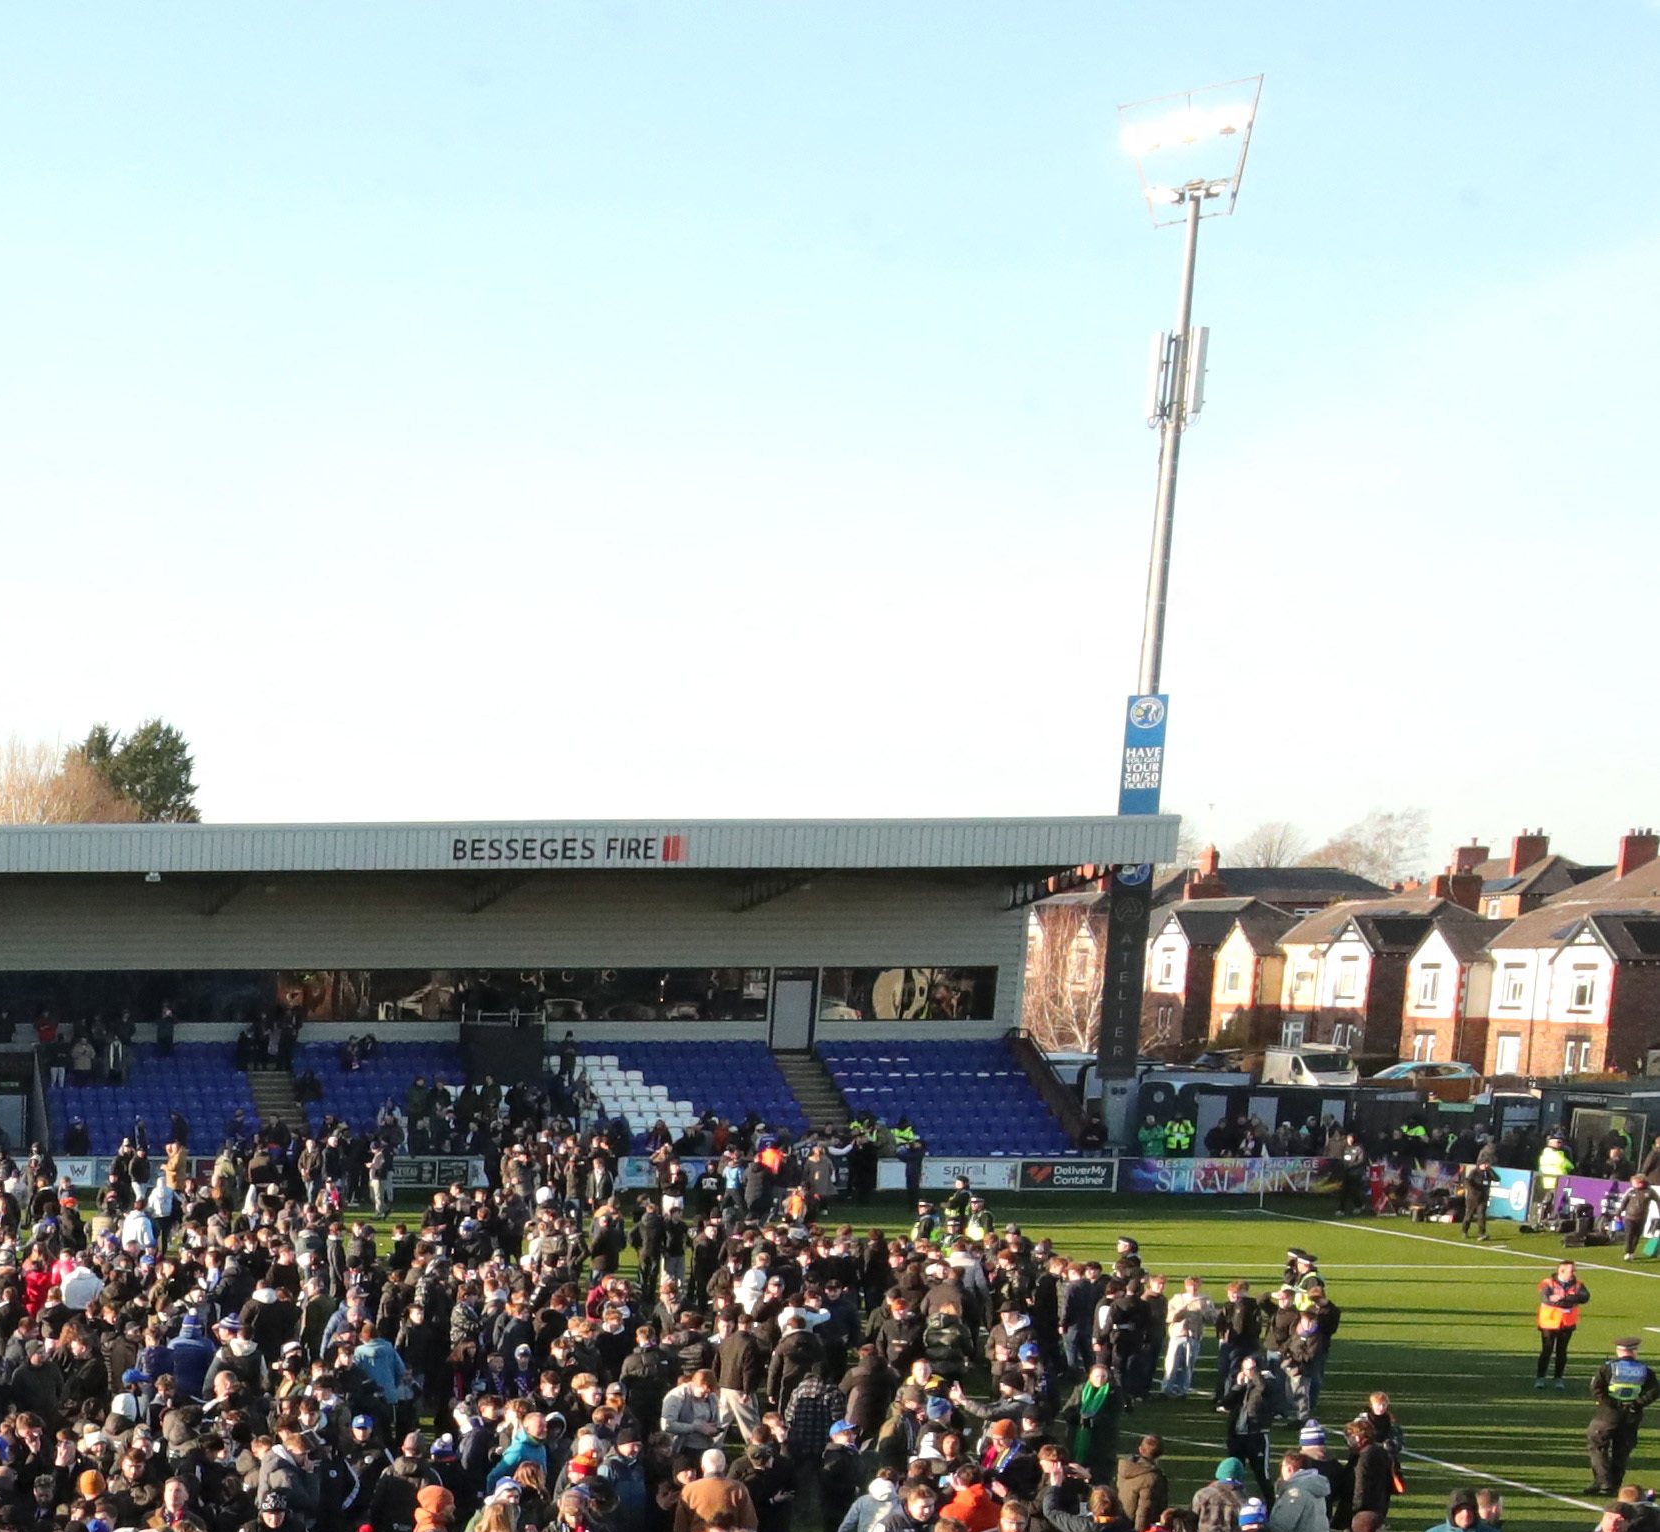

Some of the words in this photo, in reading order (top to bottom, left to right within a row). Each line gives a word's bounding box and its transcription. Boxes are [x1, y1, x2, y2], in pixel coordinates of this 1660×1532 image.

[1126, 747, 1161, 758] HAVE
[1125, 764, 1159, 772] YOUR
[1124, 773, 1159, 782] 50/50
[453, 838, 595, 860] BESSEGES
[606, 838, 657, 859] FIRE
[1111, 934, 1132, 1057] ATELIER
[1157, 1160, 1212, 1168] BESPOKE
[1215, 1160, 1251, 1168] PRINT
[1266, 1160, 1319, 1168] SIGNAGE
[1053, 1166, 1107, 1176] DeliverMy
[1053, 1176, 1105, 1186] Container
[1155, 1170, 1231, 1192] SPIRAL
[1244, 1170, 1319, 1192] PRINT
